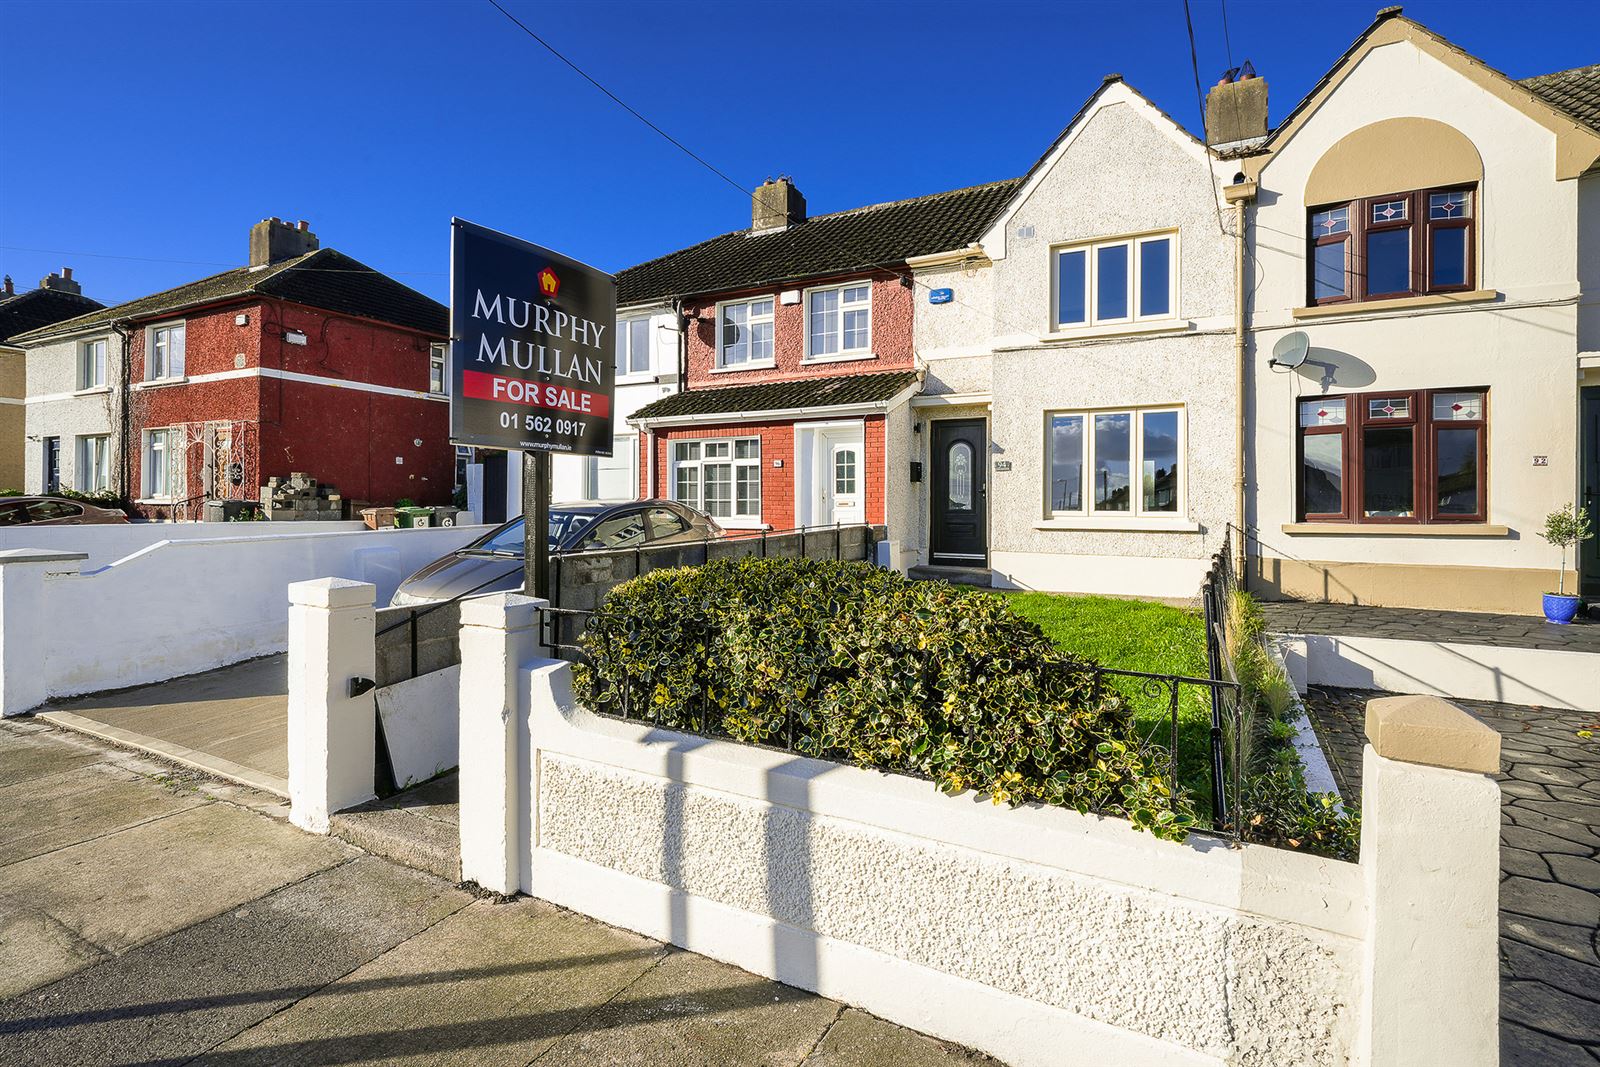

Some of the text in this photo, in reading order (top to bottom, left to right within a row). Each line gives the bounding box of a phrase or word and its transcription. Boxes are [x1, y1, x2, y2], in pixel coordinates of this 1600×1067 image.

[472, 289, 606, 349] MURPHY
[476, 333, 602, 386] MULLAN
[493, 377, 591, 412] FOR SALE
[500, 411, 586, 437] 01 562 0917
[520, 440, 572, 452] www.murphymullan.ie
